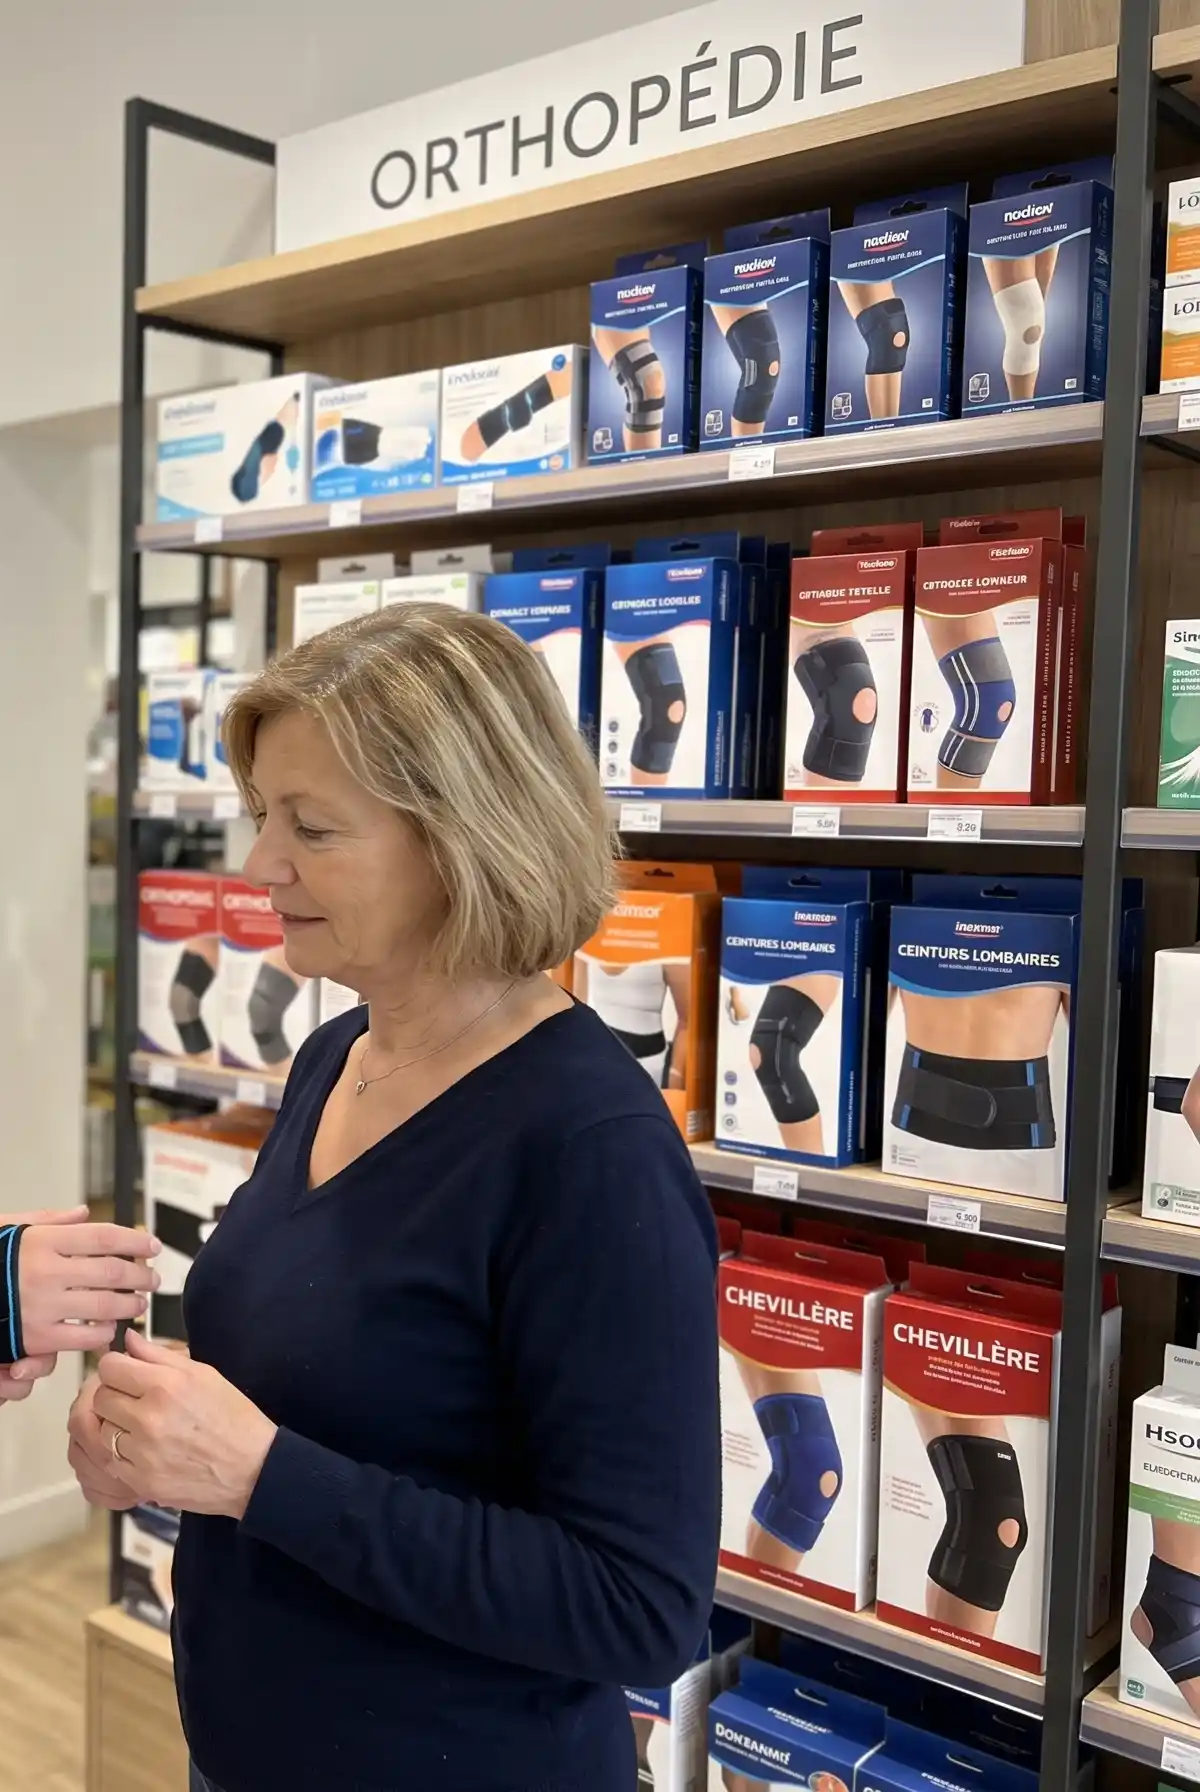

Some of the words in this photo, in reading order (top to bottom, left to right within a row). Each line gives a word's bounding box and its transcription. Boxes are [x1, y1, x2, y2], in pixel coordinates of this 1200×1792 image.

[370, 14, 864, 210] ORTHOPÉDIE
[897, 944, 970, 961] CEINTURS
[972, 949, 1061, 968] LOMBAIRES
[725, 1285, 854, 1331] CHEVILLÈRE
[892, 1322, 1040, 1373] CHEVILLÈRE
